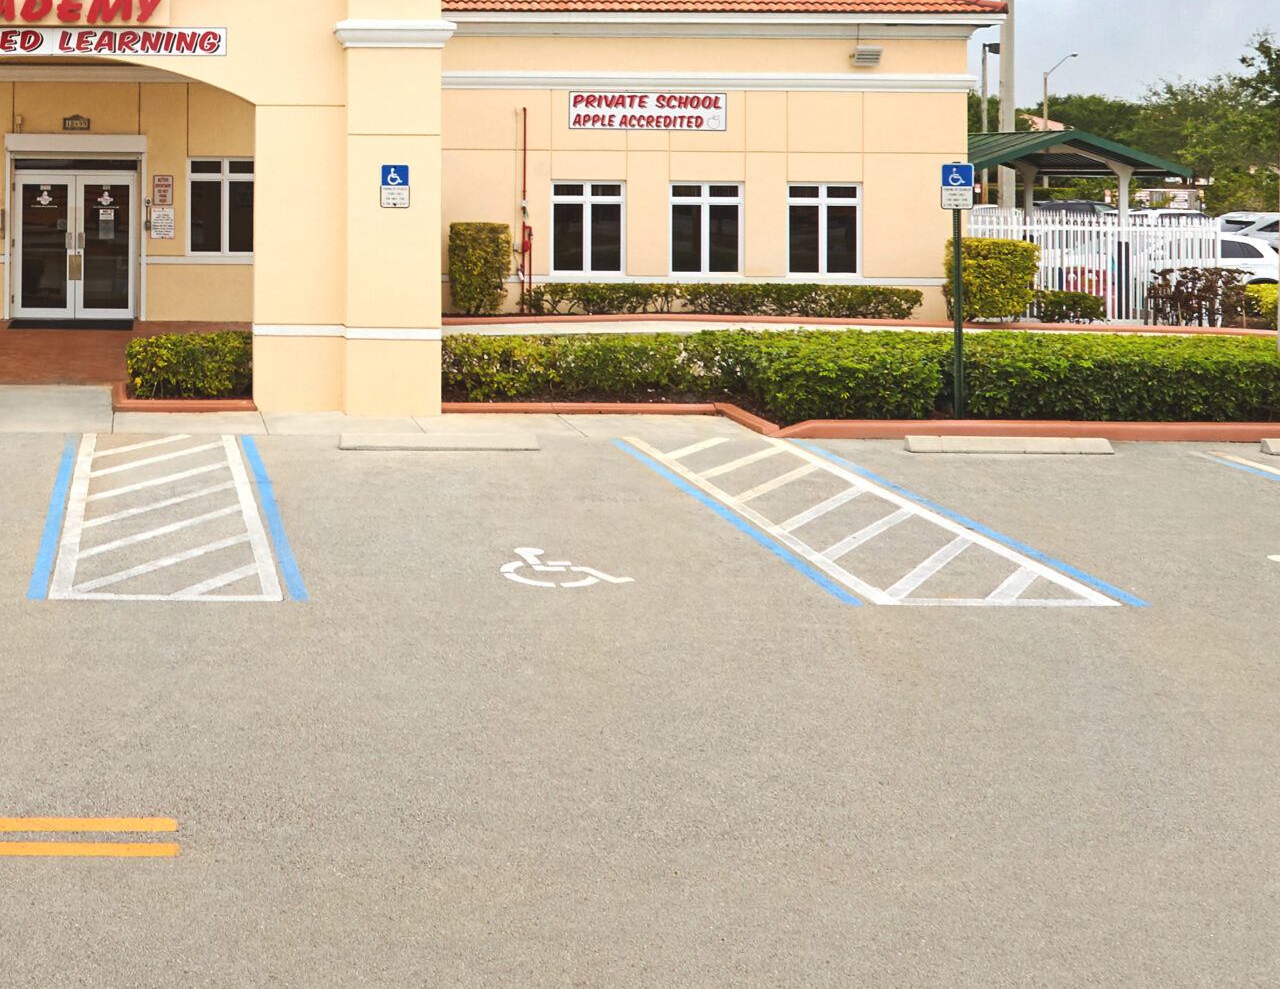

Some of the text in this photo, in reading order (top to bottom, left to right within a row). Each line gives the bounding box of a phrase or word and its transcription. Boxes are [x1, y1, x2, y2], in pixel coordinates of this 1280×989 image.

[58, 30, 221, 54] LEARNING
[573, 94, 722, 109] PRIVATE SCHOOL
[573, 113, 704, 129] APPLE ACCREDITED
